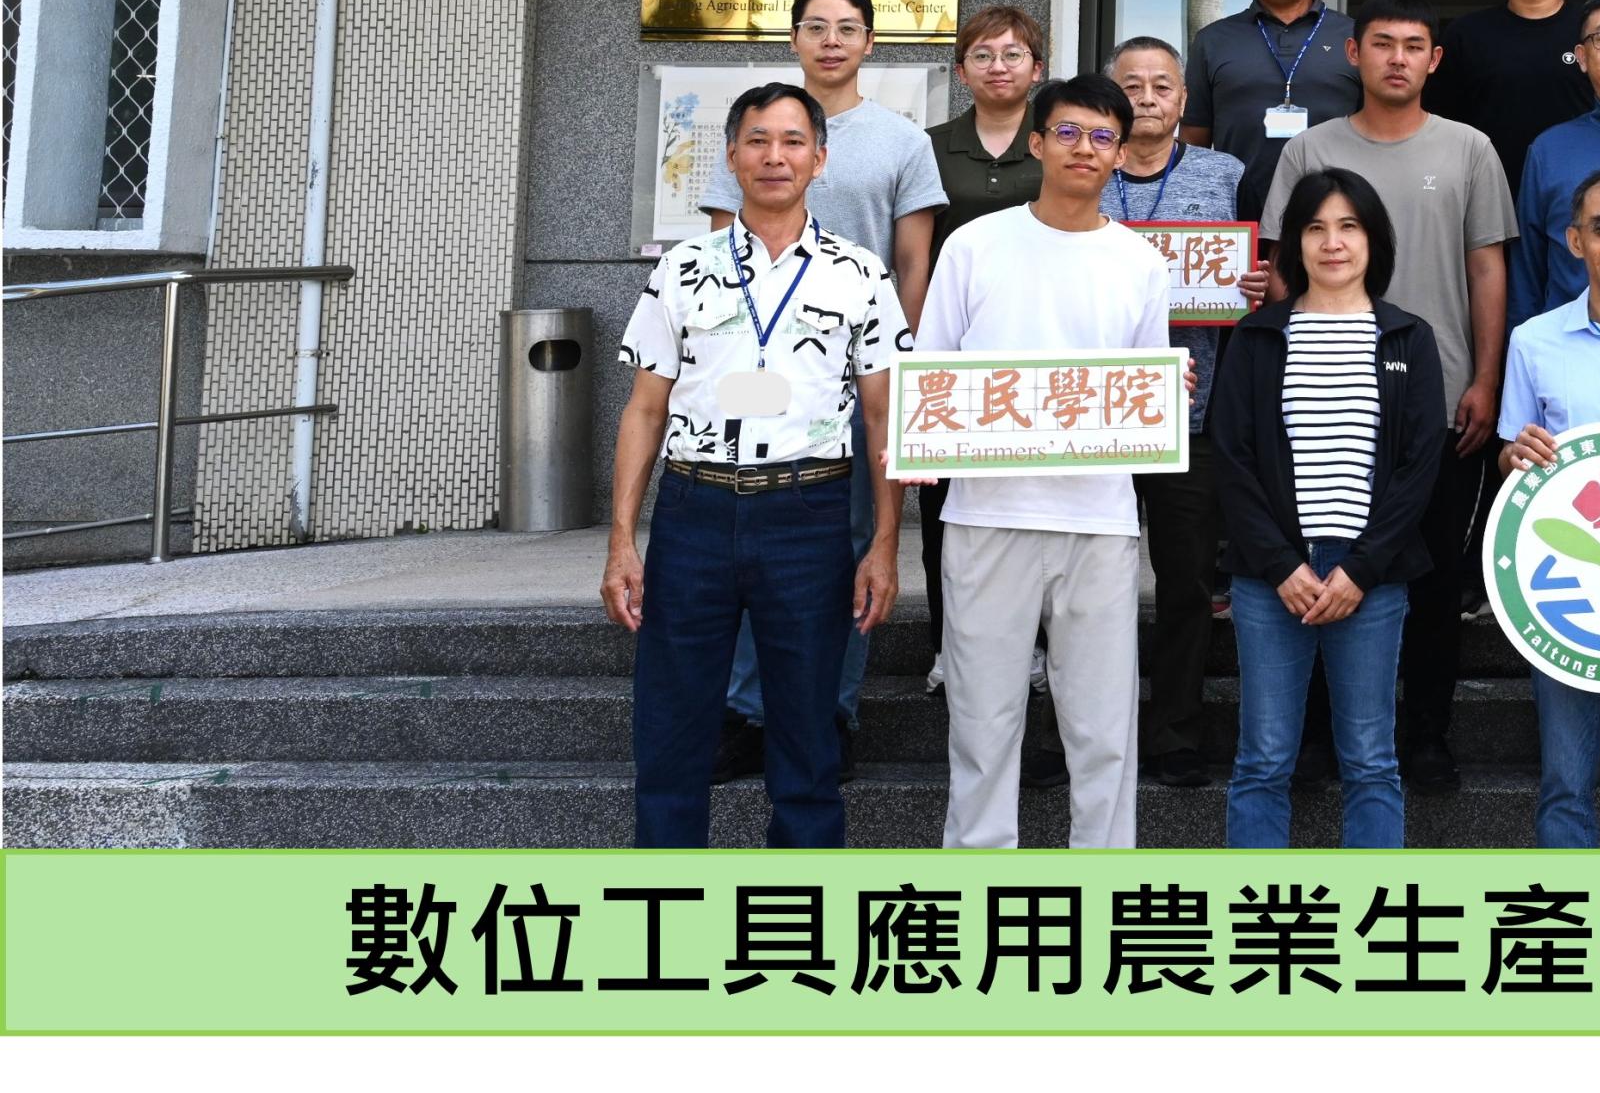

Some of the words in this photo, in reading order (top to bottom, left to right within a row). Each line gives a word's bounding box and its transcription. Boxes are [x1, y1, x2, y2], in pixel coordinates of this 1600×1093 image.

[874, 2, 901, 13] strict
[905, 1, 946, 14] Center
[904, 366, 1164, 434] 農民學院
[904, 442, 947, 464] The
[1063, 439, 1167, 463] Academy
[1521, 622, 1598, 679] Taitung
